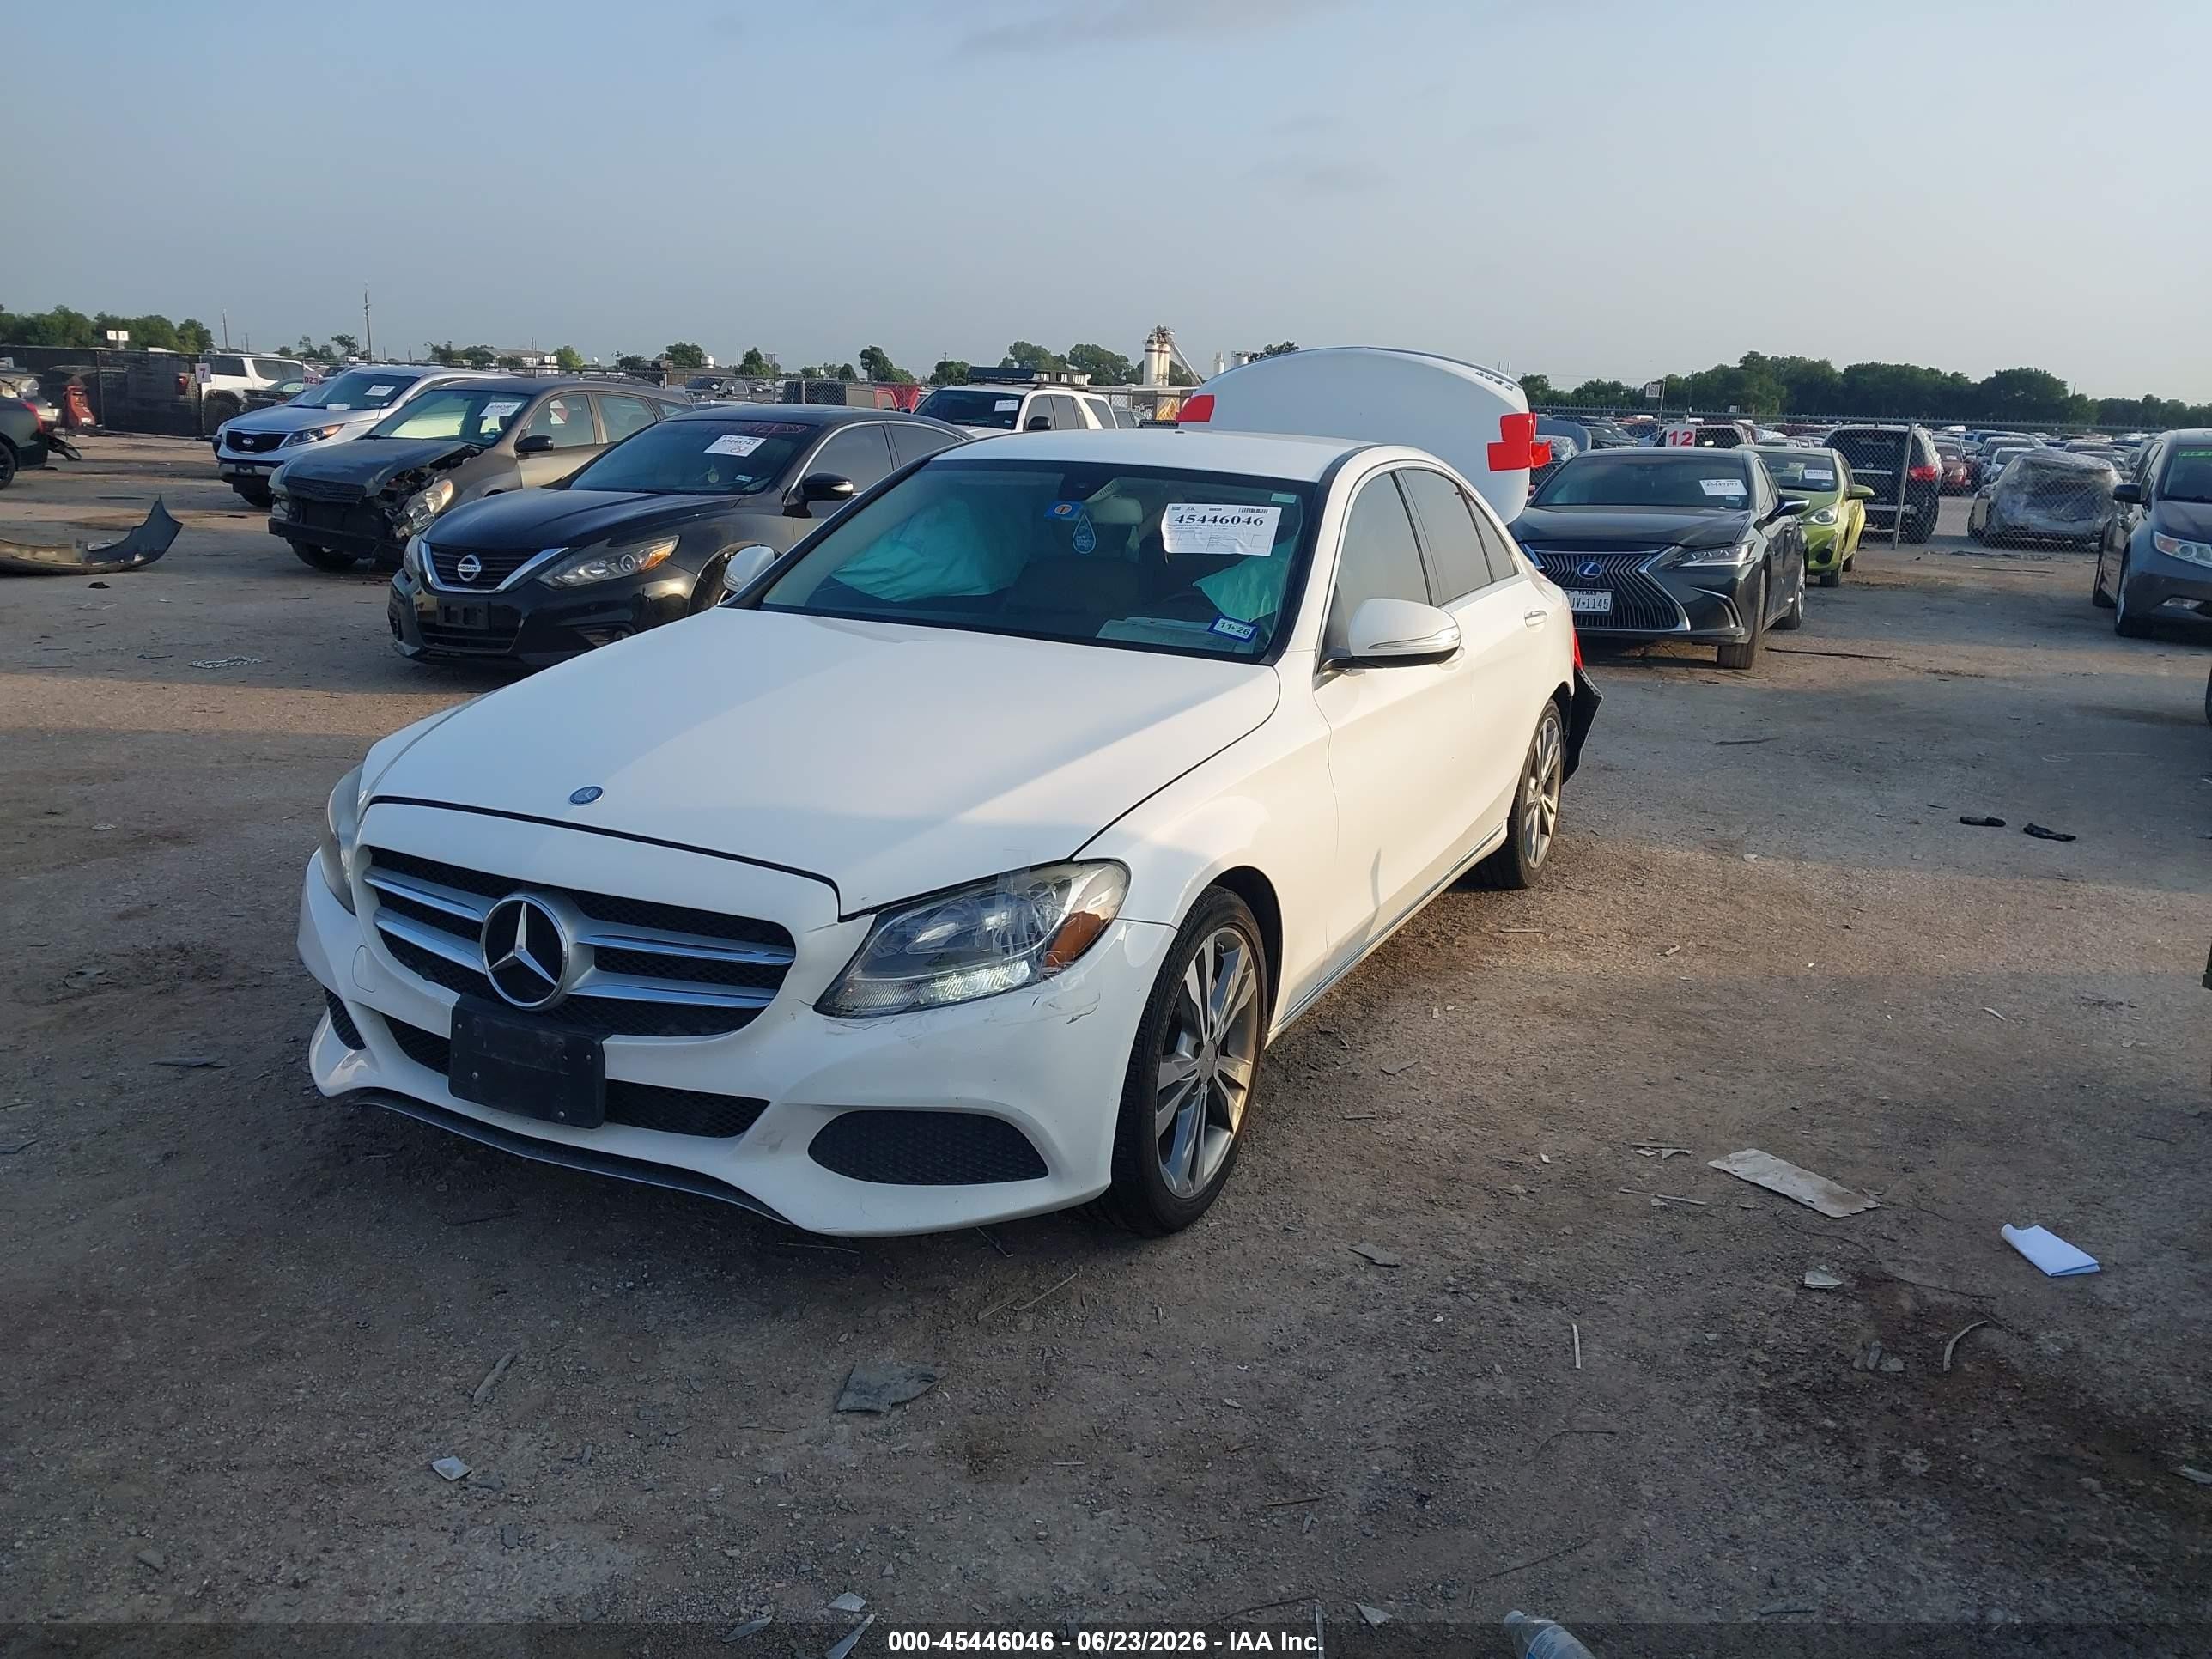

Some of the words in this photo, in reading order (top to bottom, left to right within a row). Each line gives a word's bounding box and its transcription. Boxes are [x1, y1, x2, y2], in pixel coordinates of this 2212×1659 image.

[198, 368, 207, 379] 7
[1668, 429, 1694, 447] 12
[1174, 514, 1265, 526] 45446046
